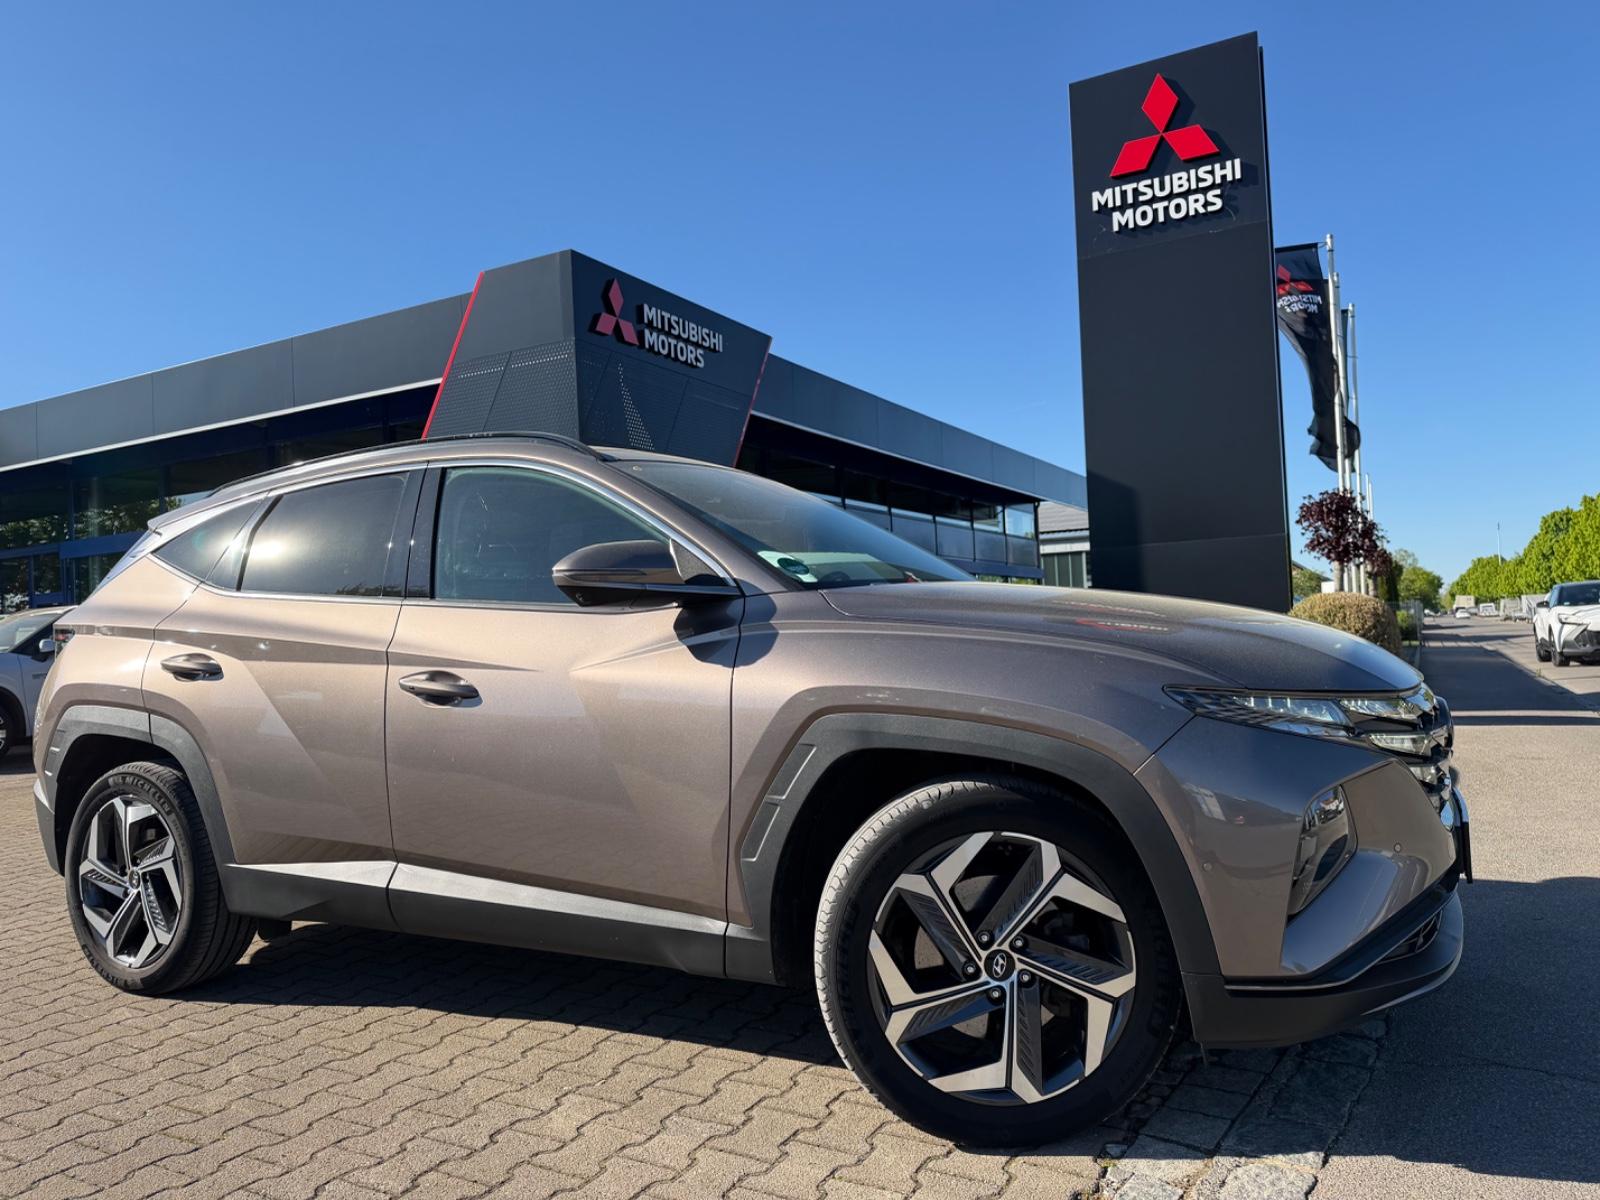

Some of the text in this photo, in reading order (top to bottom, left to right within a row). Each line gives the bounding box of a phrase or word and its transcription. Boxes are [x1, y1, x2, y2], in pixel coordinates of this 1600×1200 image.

[1091, 158, 1242, 212] MITSUBISHI
[1112, 189, 1224, 233] MOTORS
[643, 303, 723, 353] MITSUBISHI
[644, 329, 705, 369] MOTORS
[125, 776, 171, 812] MICHELIN
